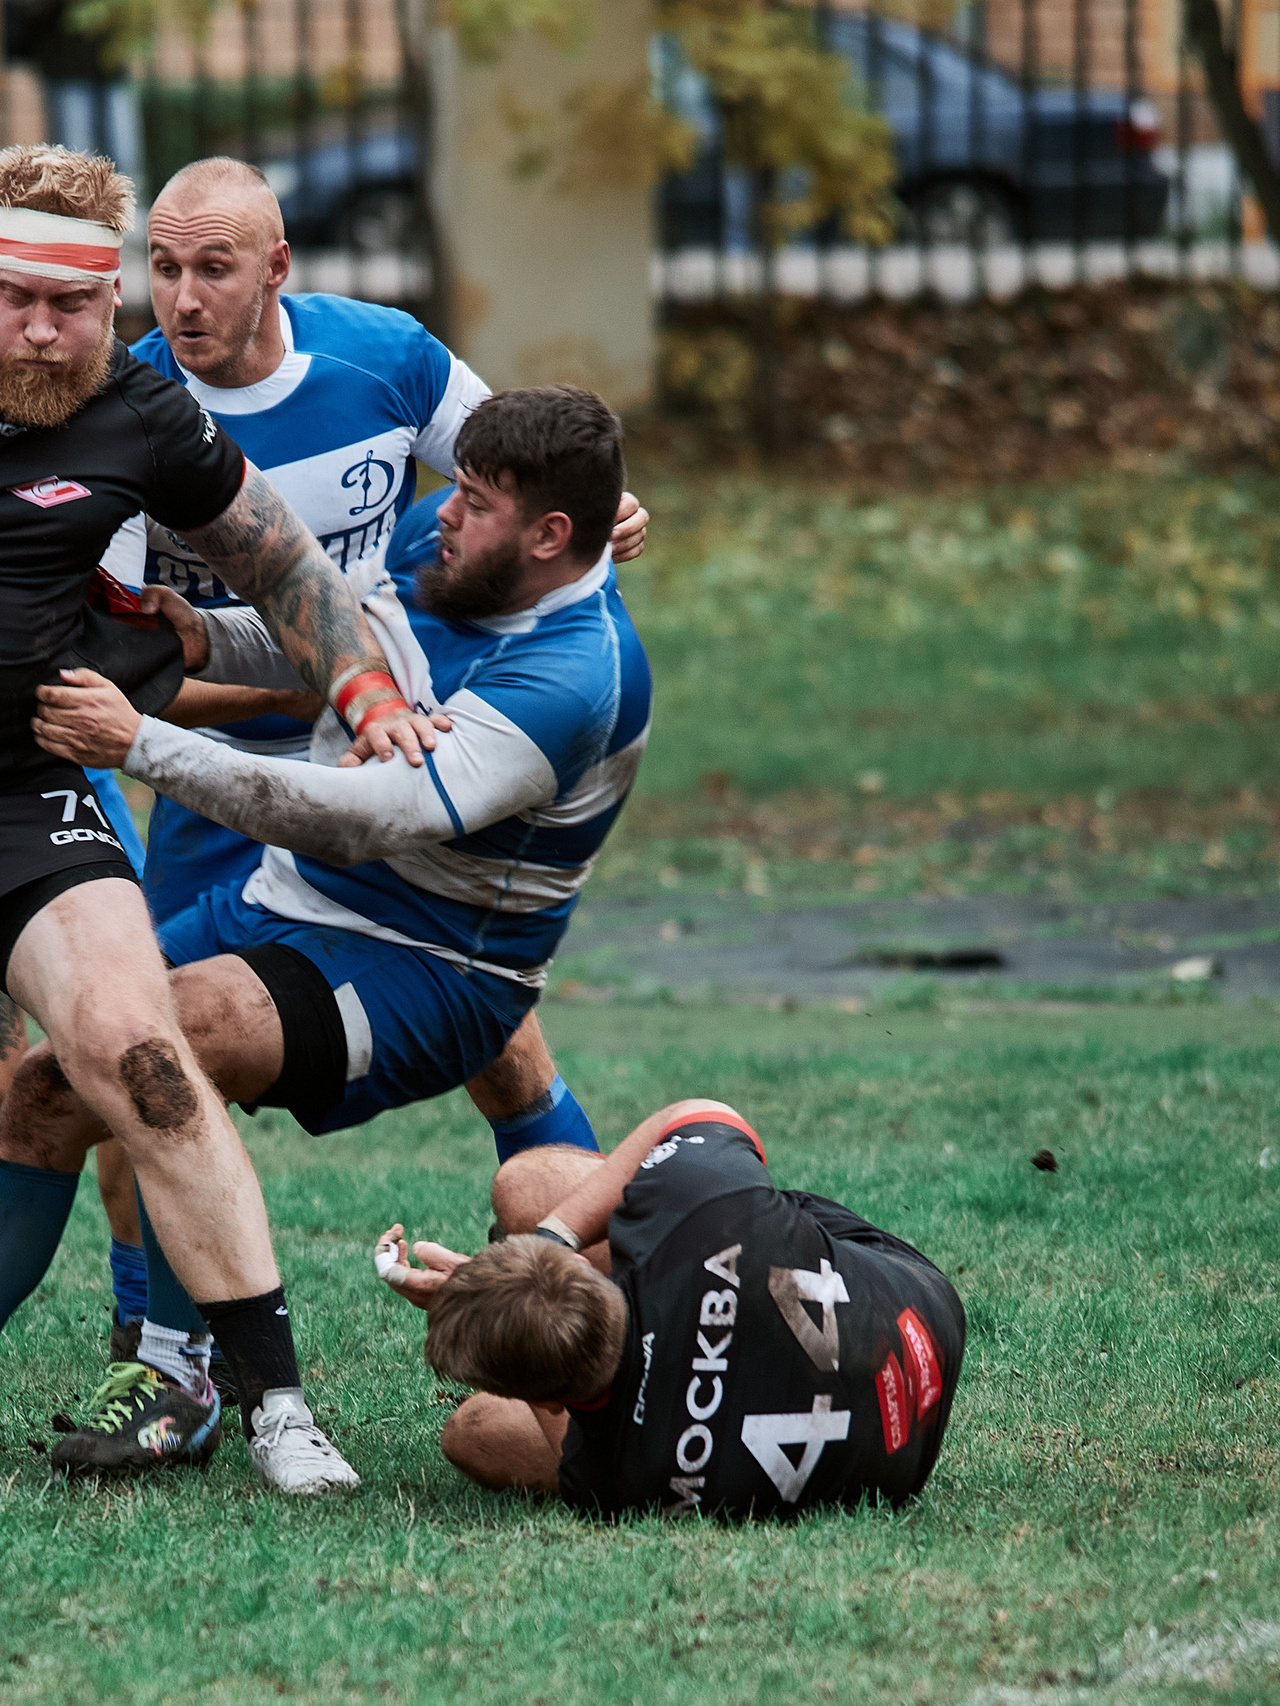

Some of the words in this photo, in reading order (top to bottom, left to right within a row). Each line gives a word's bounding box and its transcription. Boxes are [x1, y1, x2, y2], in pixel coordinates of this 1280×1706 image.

[40, 789, 110, 830] 71
[49, 828, 125, 854] GONG
[667, 1242, 743, 1513] МОСКВА
[740, 1257, 852, 1504] 44
